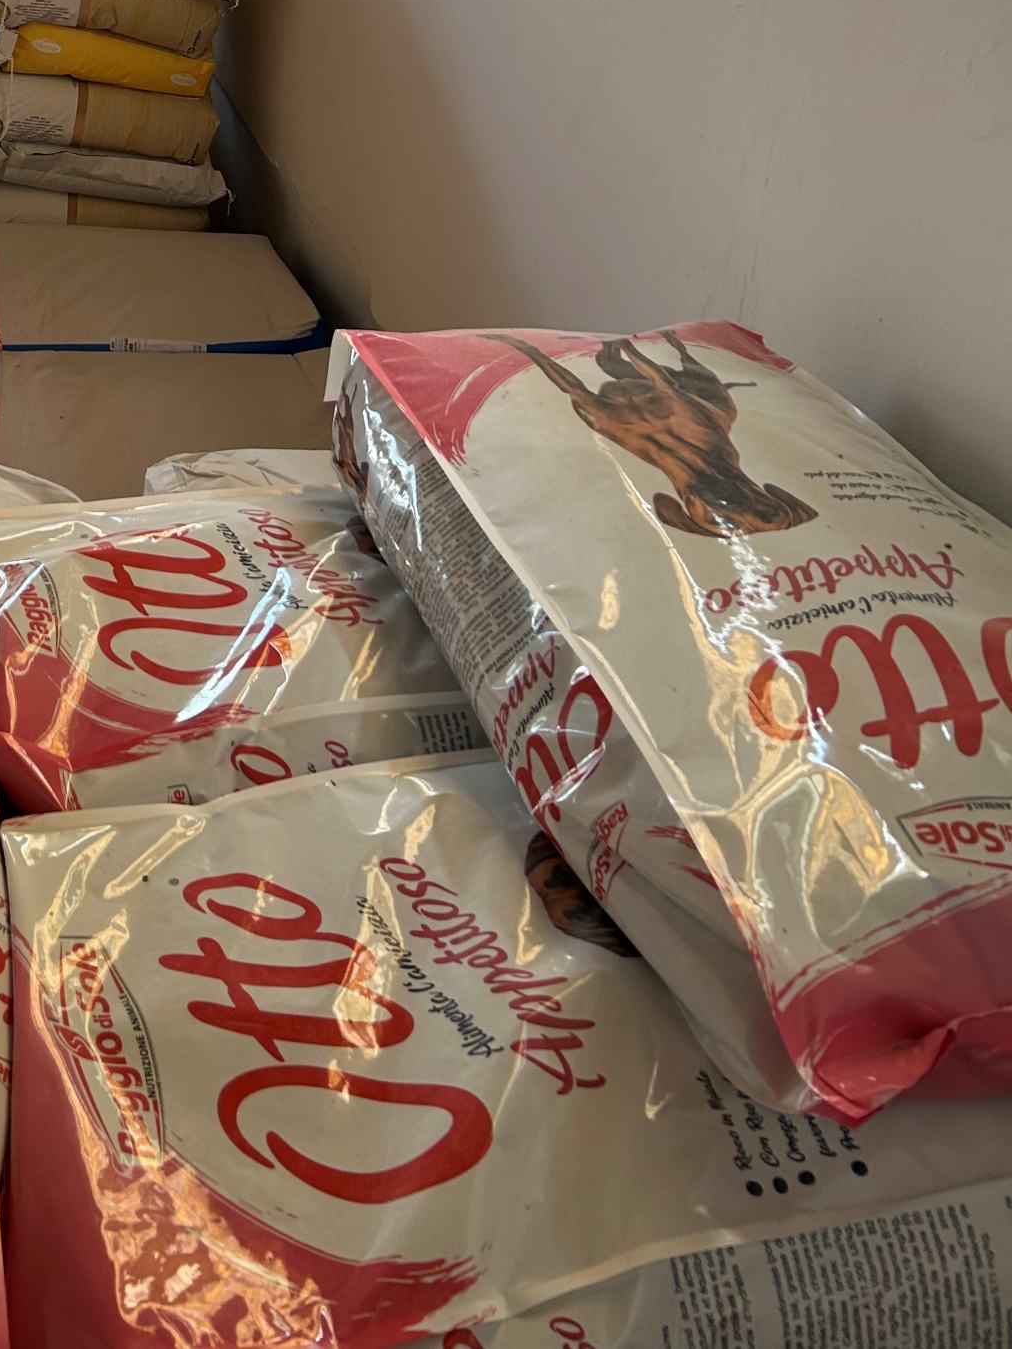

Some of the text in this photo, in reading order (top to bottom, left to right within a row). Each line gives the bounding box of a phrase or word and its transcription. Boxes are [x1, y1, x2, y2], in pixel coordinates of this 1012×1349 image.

[766, 590, 957, 631] Alimenta l'amicizia
[915, 821, 1004, 856] Sole
[380, 856, 606, 1095] Appetitoso
[65, 942, 156, 1158] Raggio di Sole
[118, 993, 157, 1099] NUTRIZIONE ANIMALE
[159, 872, 493, 1203] Otto
[427, 989, 501, 1059] Alimenta
[695, 1069, 753, 1171] Ricco in Maiale
[744, 1103, 780, 1167] Con Riso
[778, 1114, 806, 1163] Omega
